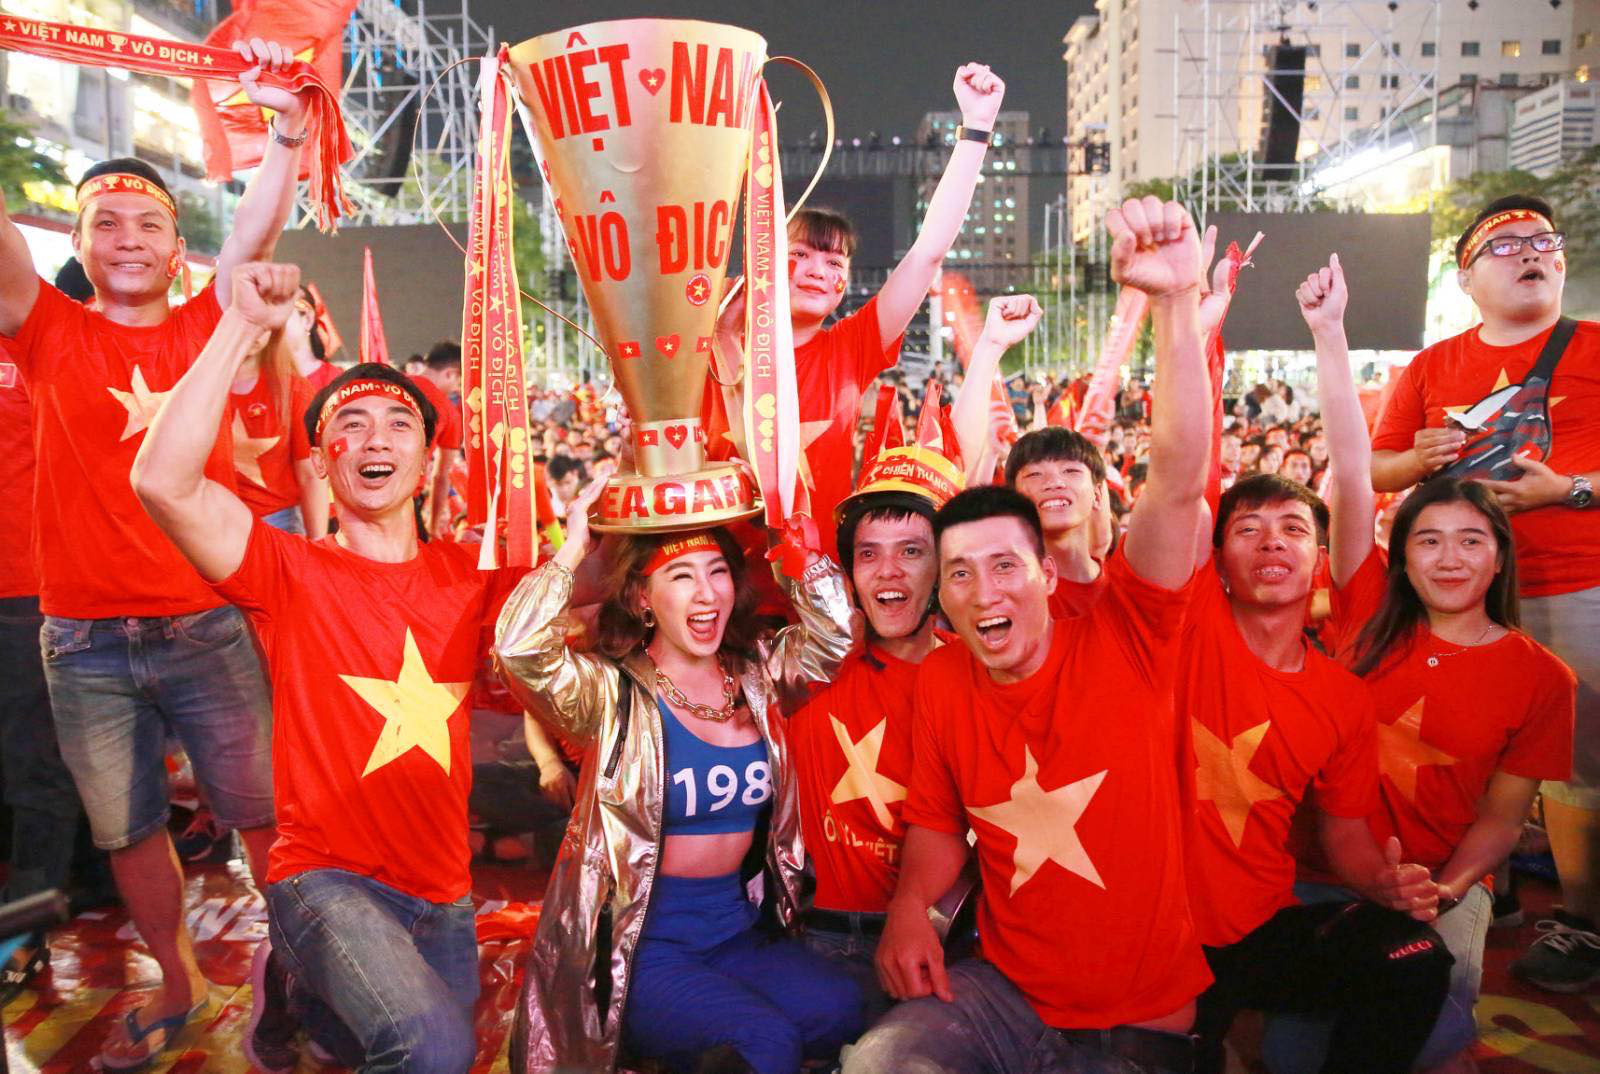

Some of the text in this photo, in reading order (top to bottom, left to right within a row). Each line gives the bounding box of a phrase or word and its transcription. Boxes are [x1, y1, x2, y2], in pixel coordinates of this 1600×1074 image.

[19, 21, 199, 63] VIỆT NAM VÔ ĐỊCH
[529, 32, 632, 152] VIỆT
[574, 190, 632, 283] VÔ
[752, 193, 773, 272] VIỆT NAM
[1484, 213, 1511, 231] NAM
[488, 322, 505, 404] VÔ ĐỊCH
[753, 301, 774, 378] VÔ ĐỊCH
[341, 382, 374, 400] NAM
